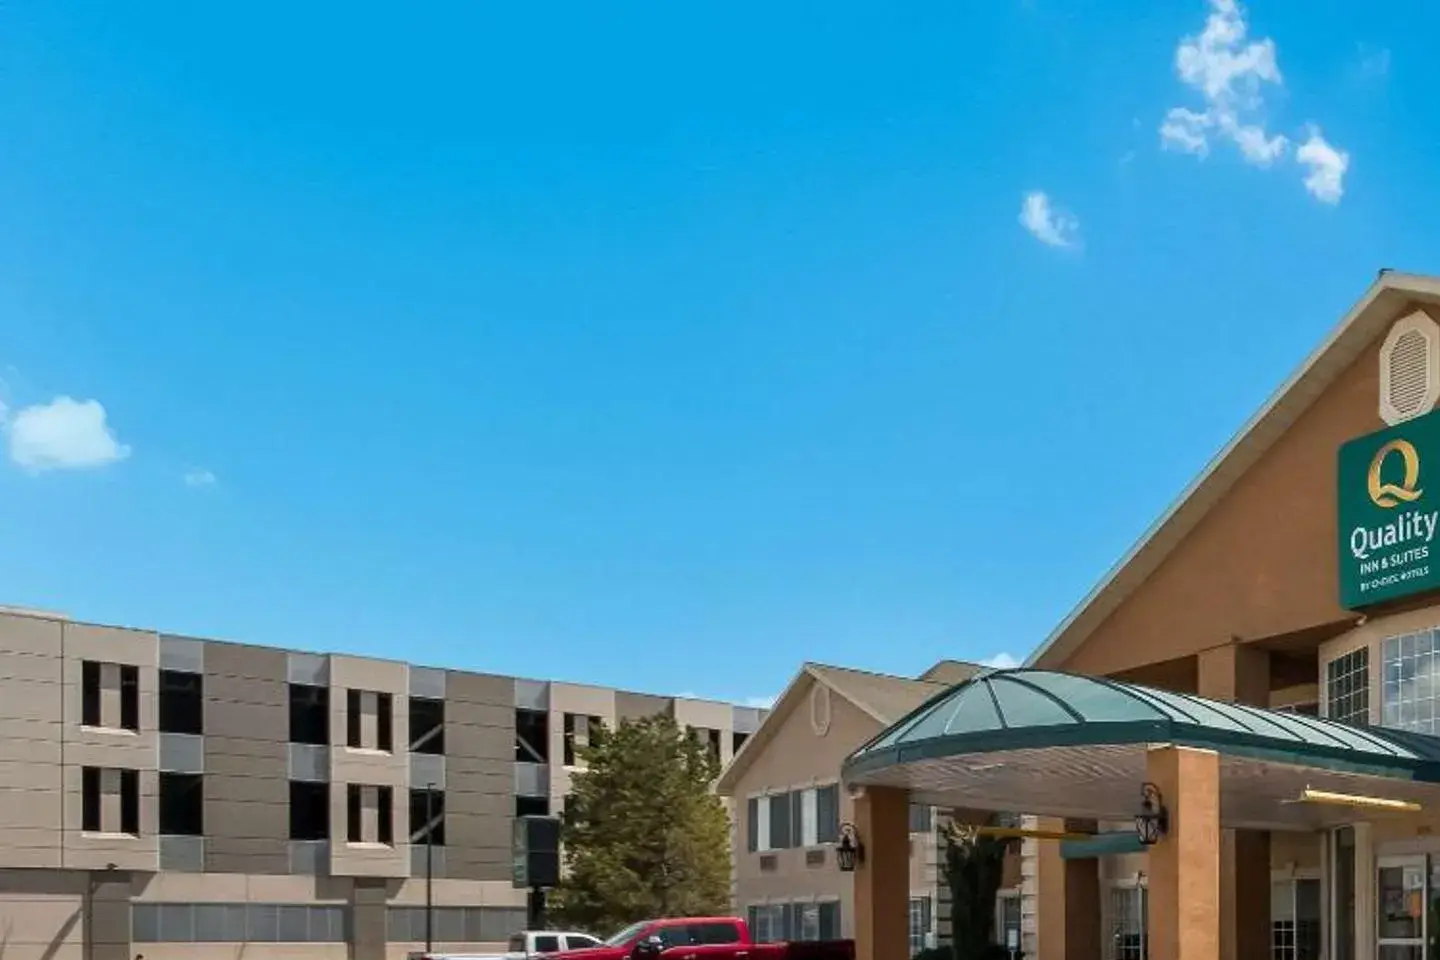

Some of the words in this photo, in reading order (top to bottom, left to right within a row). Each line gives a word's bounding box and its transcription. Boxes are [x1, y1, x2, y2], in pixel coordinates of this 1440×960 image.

[1368, 439, 1424, 508] Q
[1351, 511, 1438, 559] Quality
[1360, 560, 1380, 576] INN
[1381, 557, 1388, 569] &
[1390, 546, 1429, 567] SUITES
